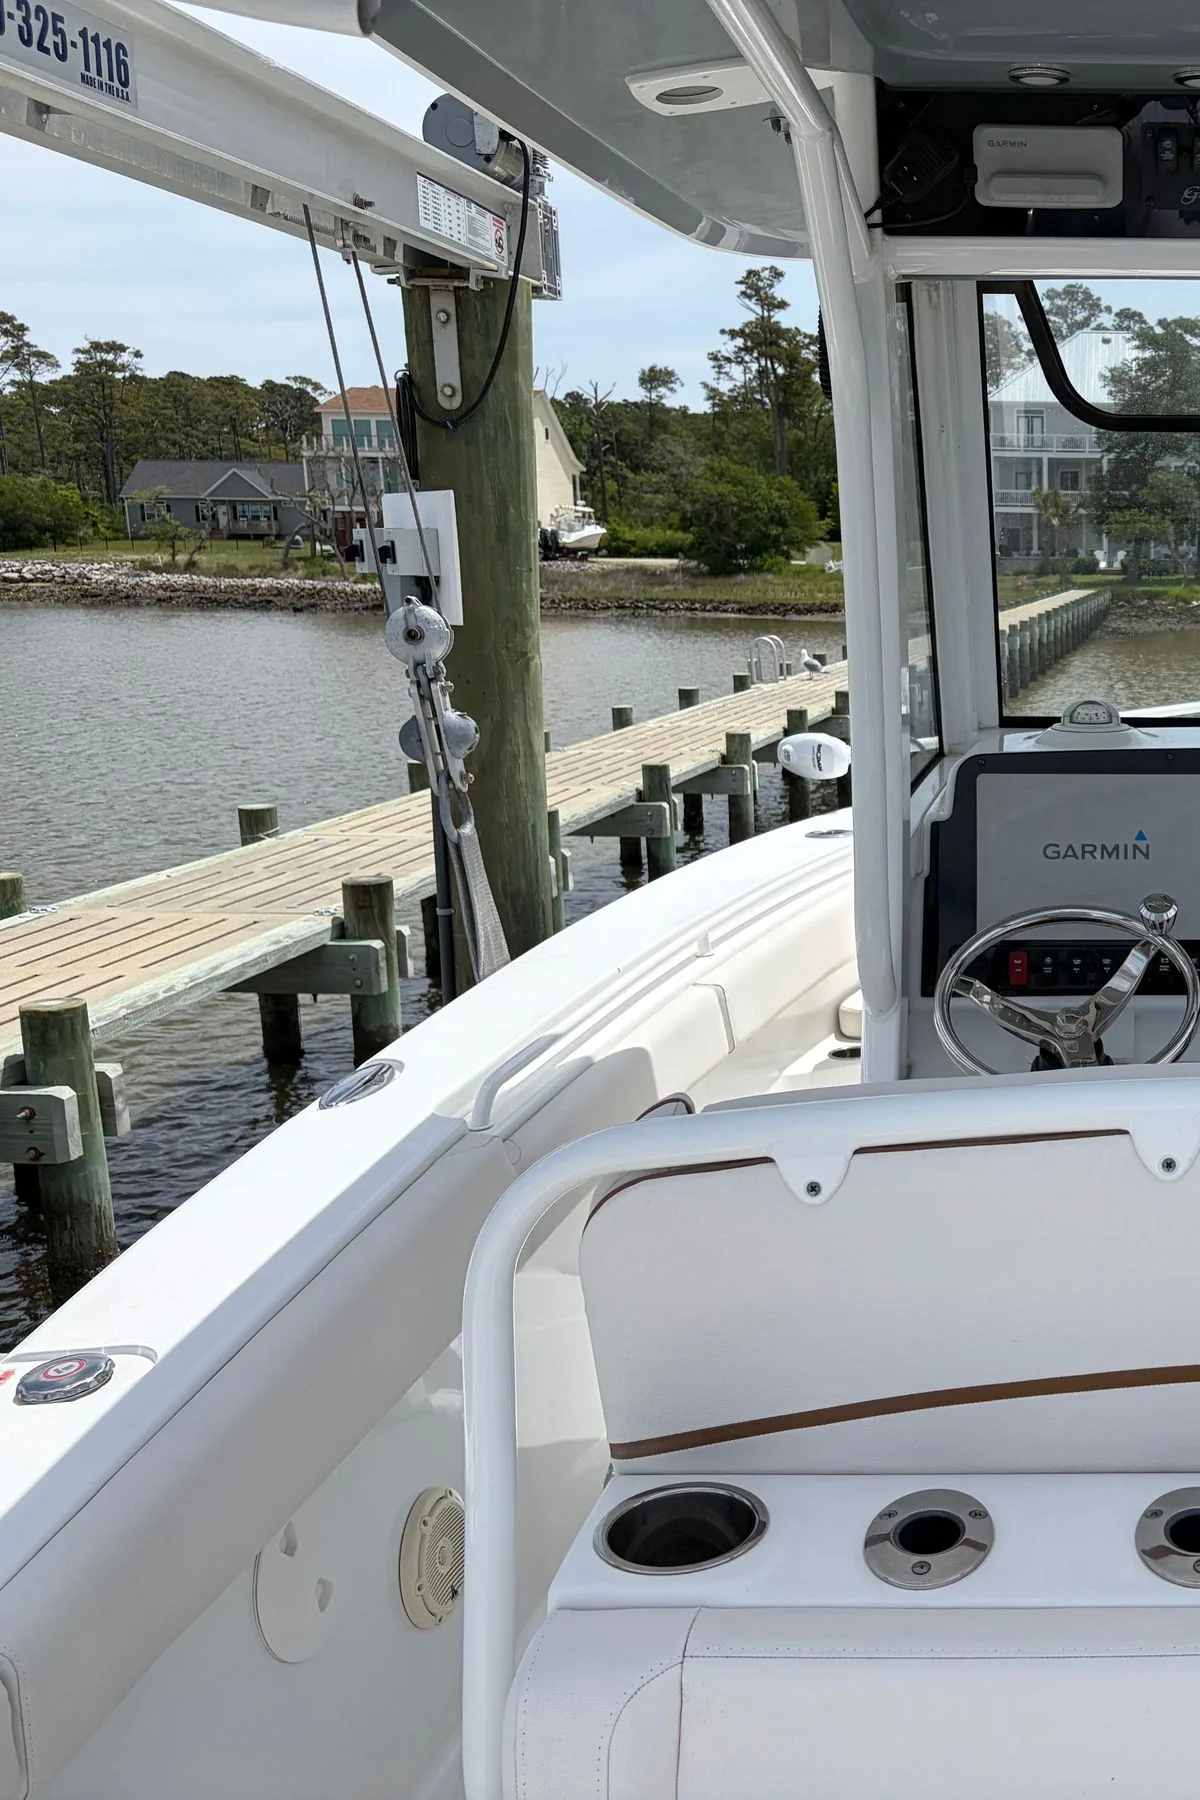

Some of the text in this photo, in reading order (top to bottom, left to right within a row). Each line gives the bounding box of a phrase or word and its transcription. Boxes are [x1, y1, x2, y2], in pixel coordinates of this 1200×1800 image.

[80, 72, 97, 89] MADE
[97, 79, 104, 92] IN
[104, 82, 115, 97] THE
[987, 139, 1028, 149] GARMIN
[1042, 842, 1151, 861] GARMIN
